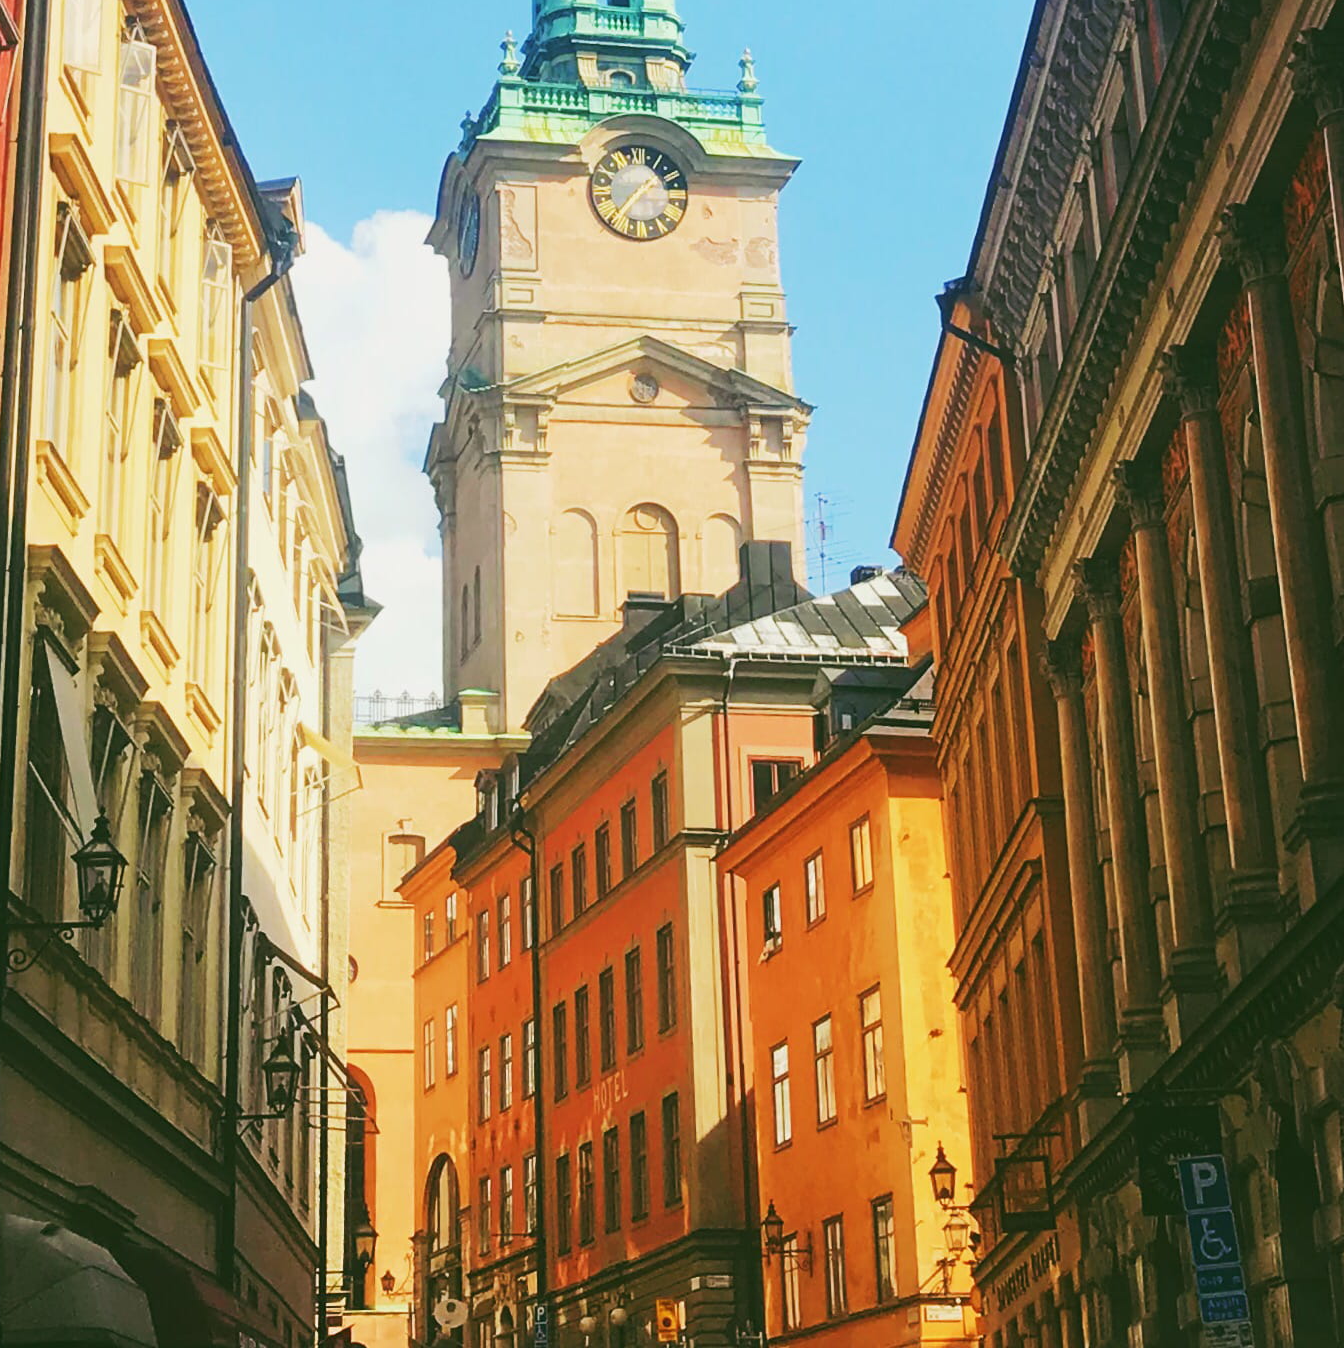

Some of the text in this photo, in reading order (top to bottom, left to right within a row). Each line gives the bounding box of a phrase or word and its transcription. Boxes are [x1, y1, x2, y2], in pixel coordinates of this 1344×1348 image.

[592, 1069, 629, 1115] HOTEL
[1191, 1162, 1218, 1205] P
[537, 1306, 545, 1321] P
